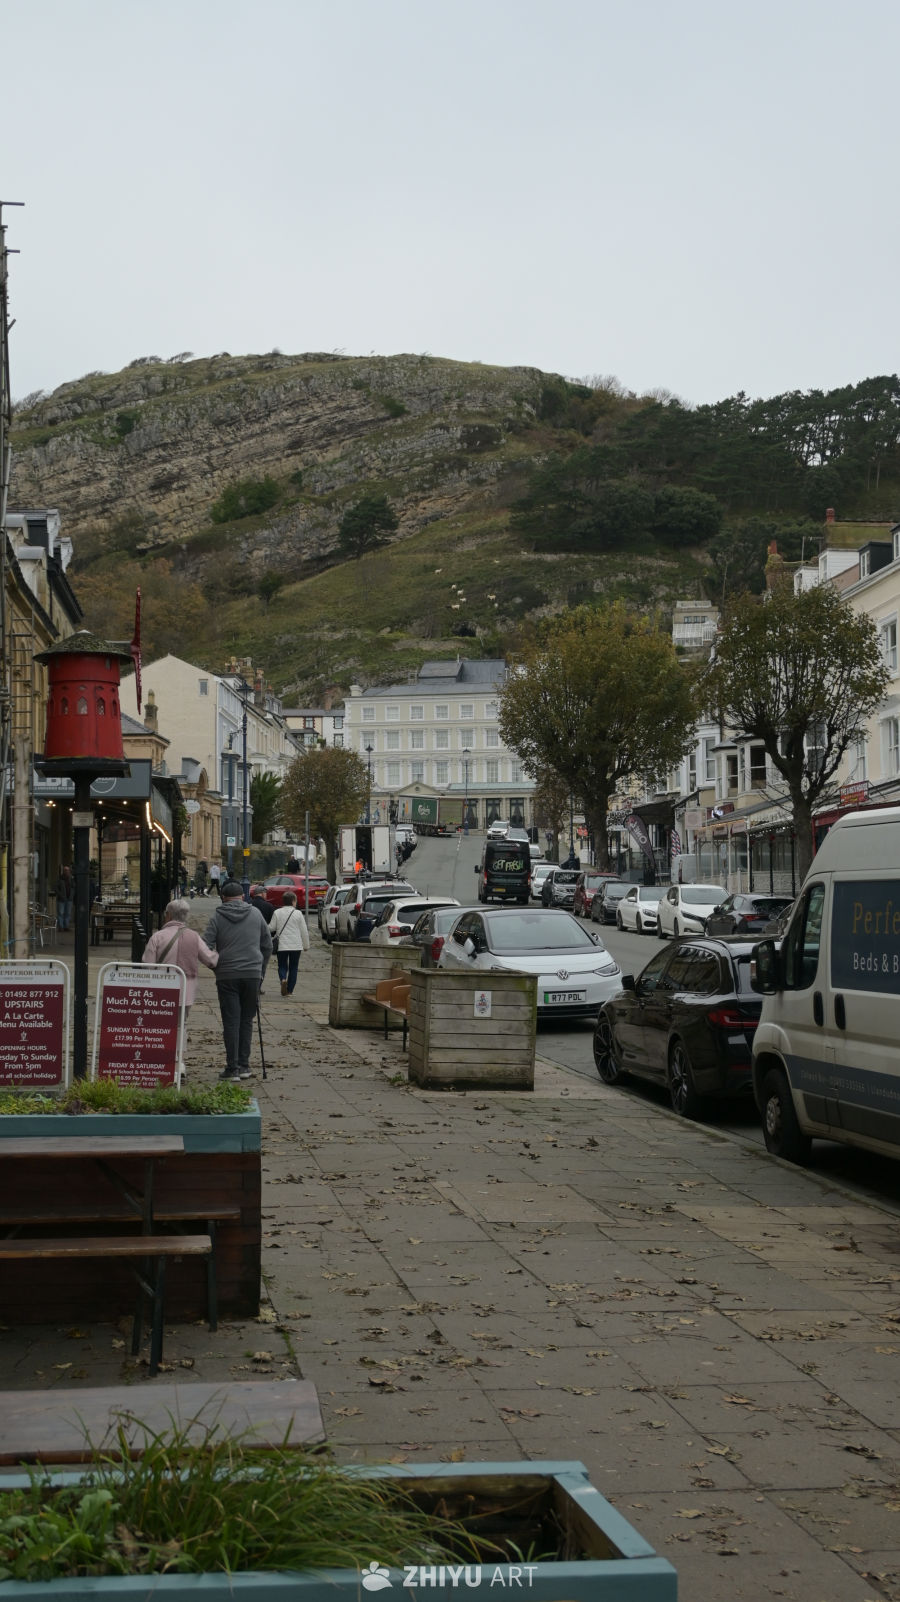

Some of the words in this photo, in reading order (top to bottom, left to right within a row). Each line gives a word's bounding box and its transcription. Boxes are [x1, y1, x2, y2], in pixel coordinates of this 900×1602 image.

[853, 952, 878, 971] Beds
[882, 954, 889, 972] &
[106, 997, 128, 1005] Much
[0, 1054, 18, 1062] esday
[31, 1053, 56, 1062] Sunday
[26, 1063, 41, 1071] 5pm
